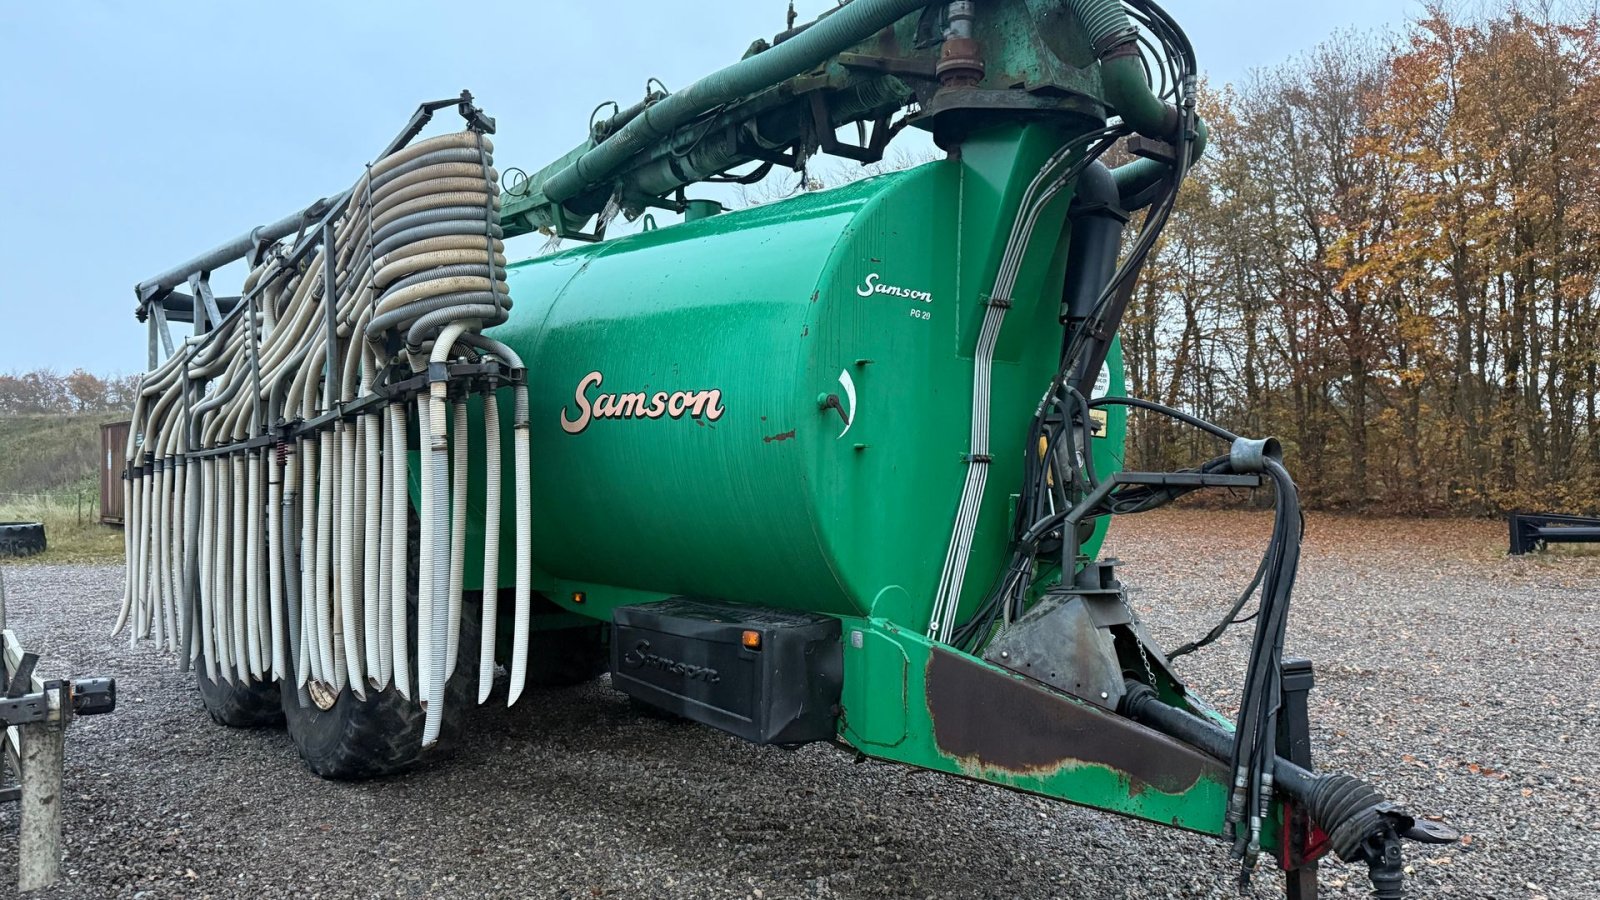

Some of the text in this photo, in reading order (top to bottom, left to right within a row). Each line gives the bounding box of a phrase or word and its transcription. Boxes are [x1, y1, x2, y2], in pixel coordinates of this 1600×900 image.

[857, 272, 933, 303] Samson
[909, 308, 921, 319] PG
[560, 371, 725, 435] Samson
[624, 638, 720, 683] Samson
